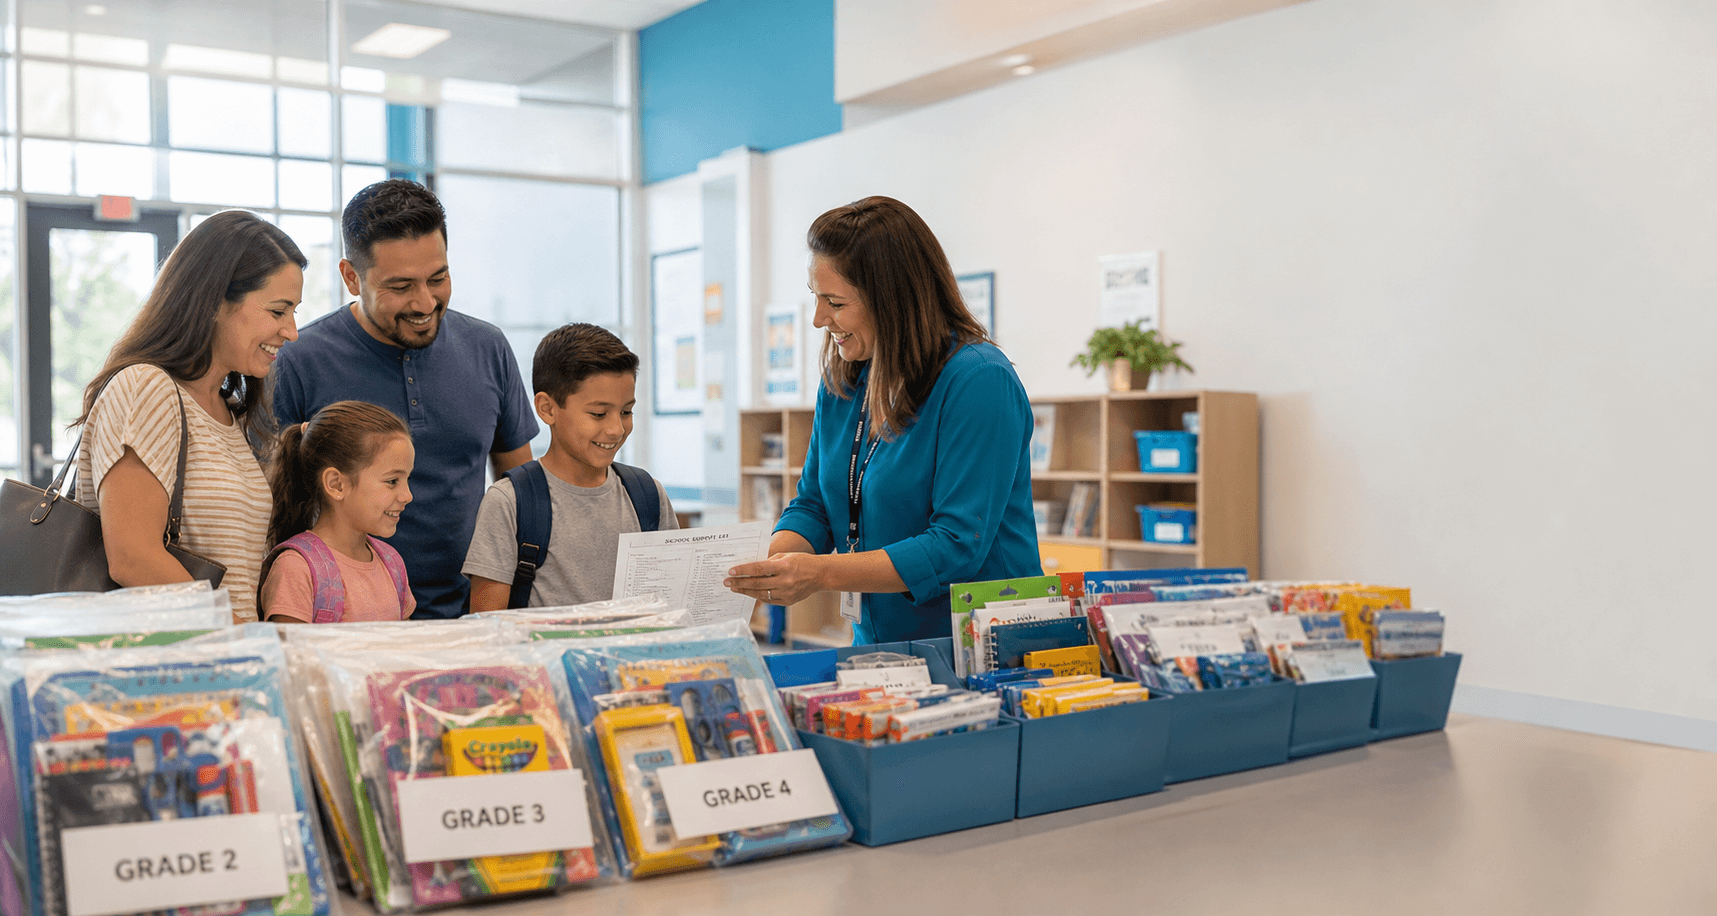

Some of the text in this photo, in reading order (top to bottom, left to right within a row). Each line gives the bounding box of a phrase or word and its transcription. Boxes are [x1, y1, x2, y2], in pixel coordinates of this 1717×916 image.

[469, 737, 531, 753] Crayola
[702, 779, 792, 808] GRADE 4
[442, 803, 545, 830] GRADE 3
[114, 848, 238, 883] GRADE 2
